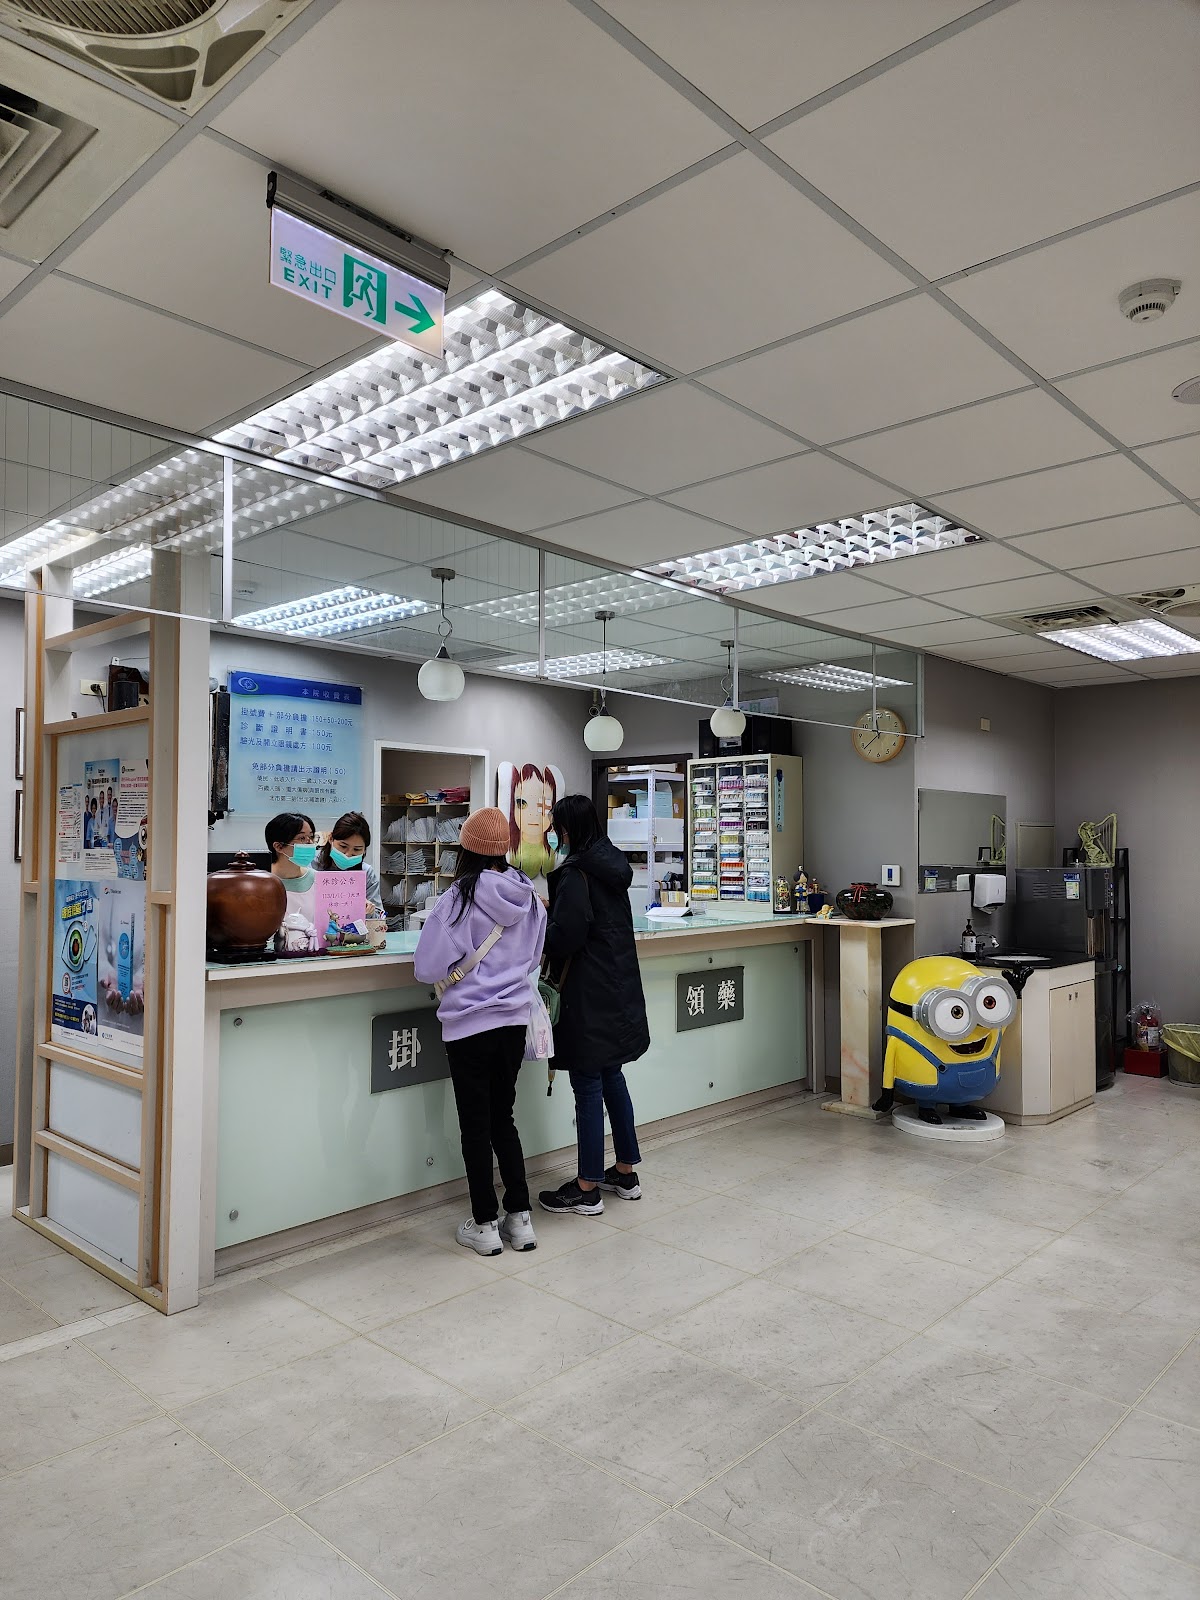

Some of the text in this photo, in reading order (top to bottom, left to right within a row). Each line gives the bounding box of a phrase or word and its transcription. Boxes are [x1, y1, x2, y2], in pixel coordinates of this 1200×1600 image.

[280, 246, 336, 285] 緊急出口
[284, 266, 333, 299] EXIT
[301, 687, 350, 701] 本院收費表
[240, 706, 266, 718] 掛號費
[240, 721, 307, 736] 診斷證明書
[322, 876, 356, 886] 休診公告
[685, 980, 736, 1016] 領藥
[388, 1027, 422, 1072] 掛
